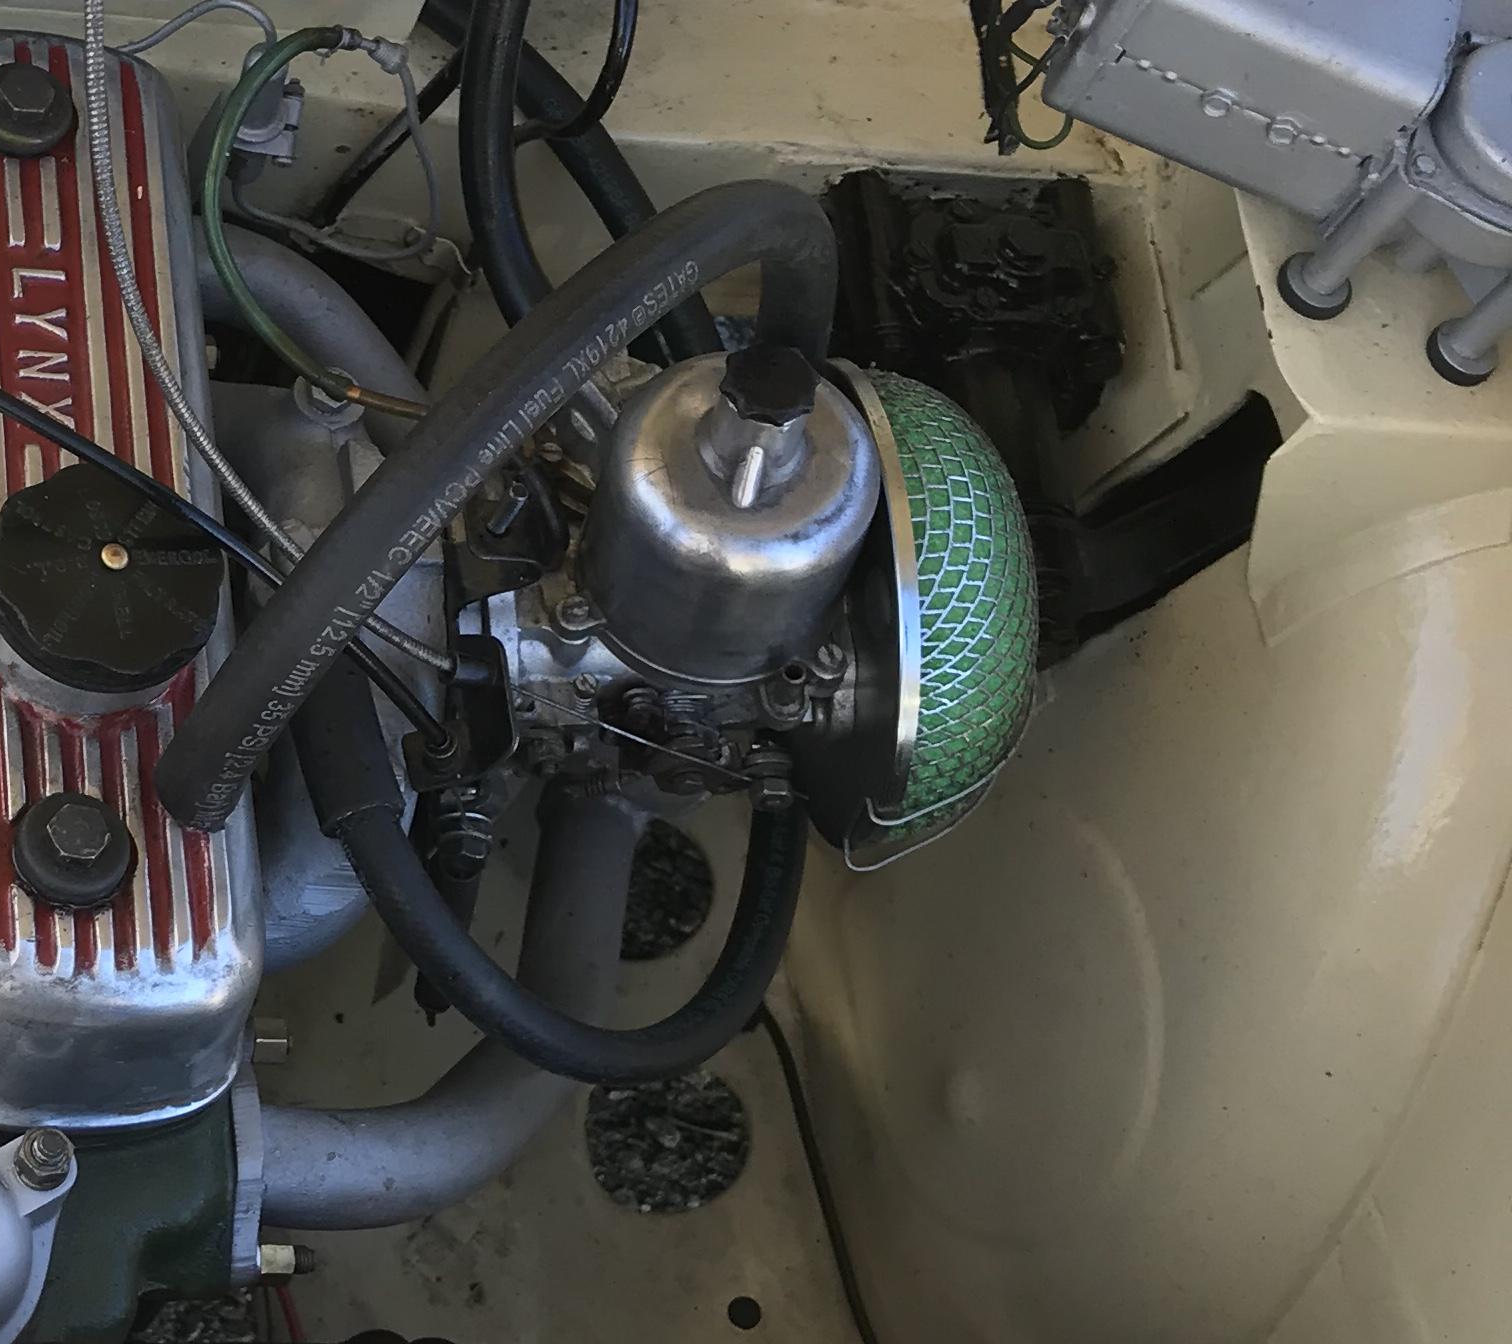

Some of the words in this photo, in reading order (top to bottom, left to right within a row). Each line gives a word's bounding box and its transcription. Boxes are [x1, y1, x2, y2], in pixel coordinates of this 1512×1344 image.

[12, 267, 76, 431] LYNX
[517, 376, 566, 430] Fuel
[478, 419, 525, 466] Line
